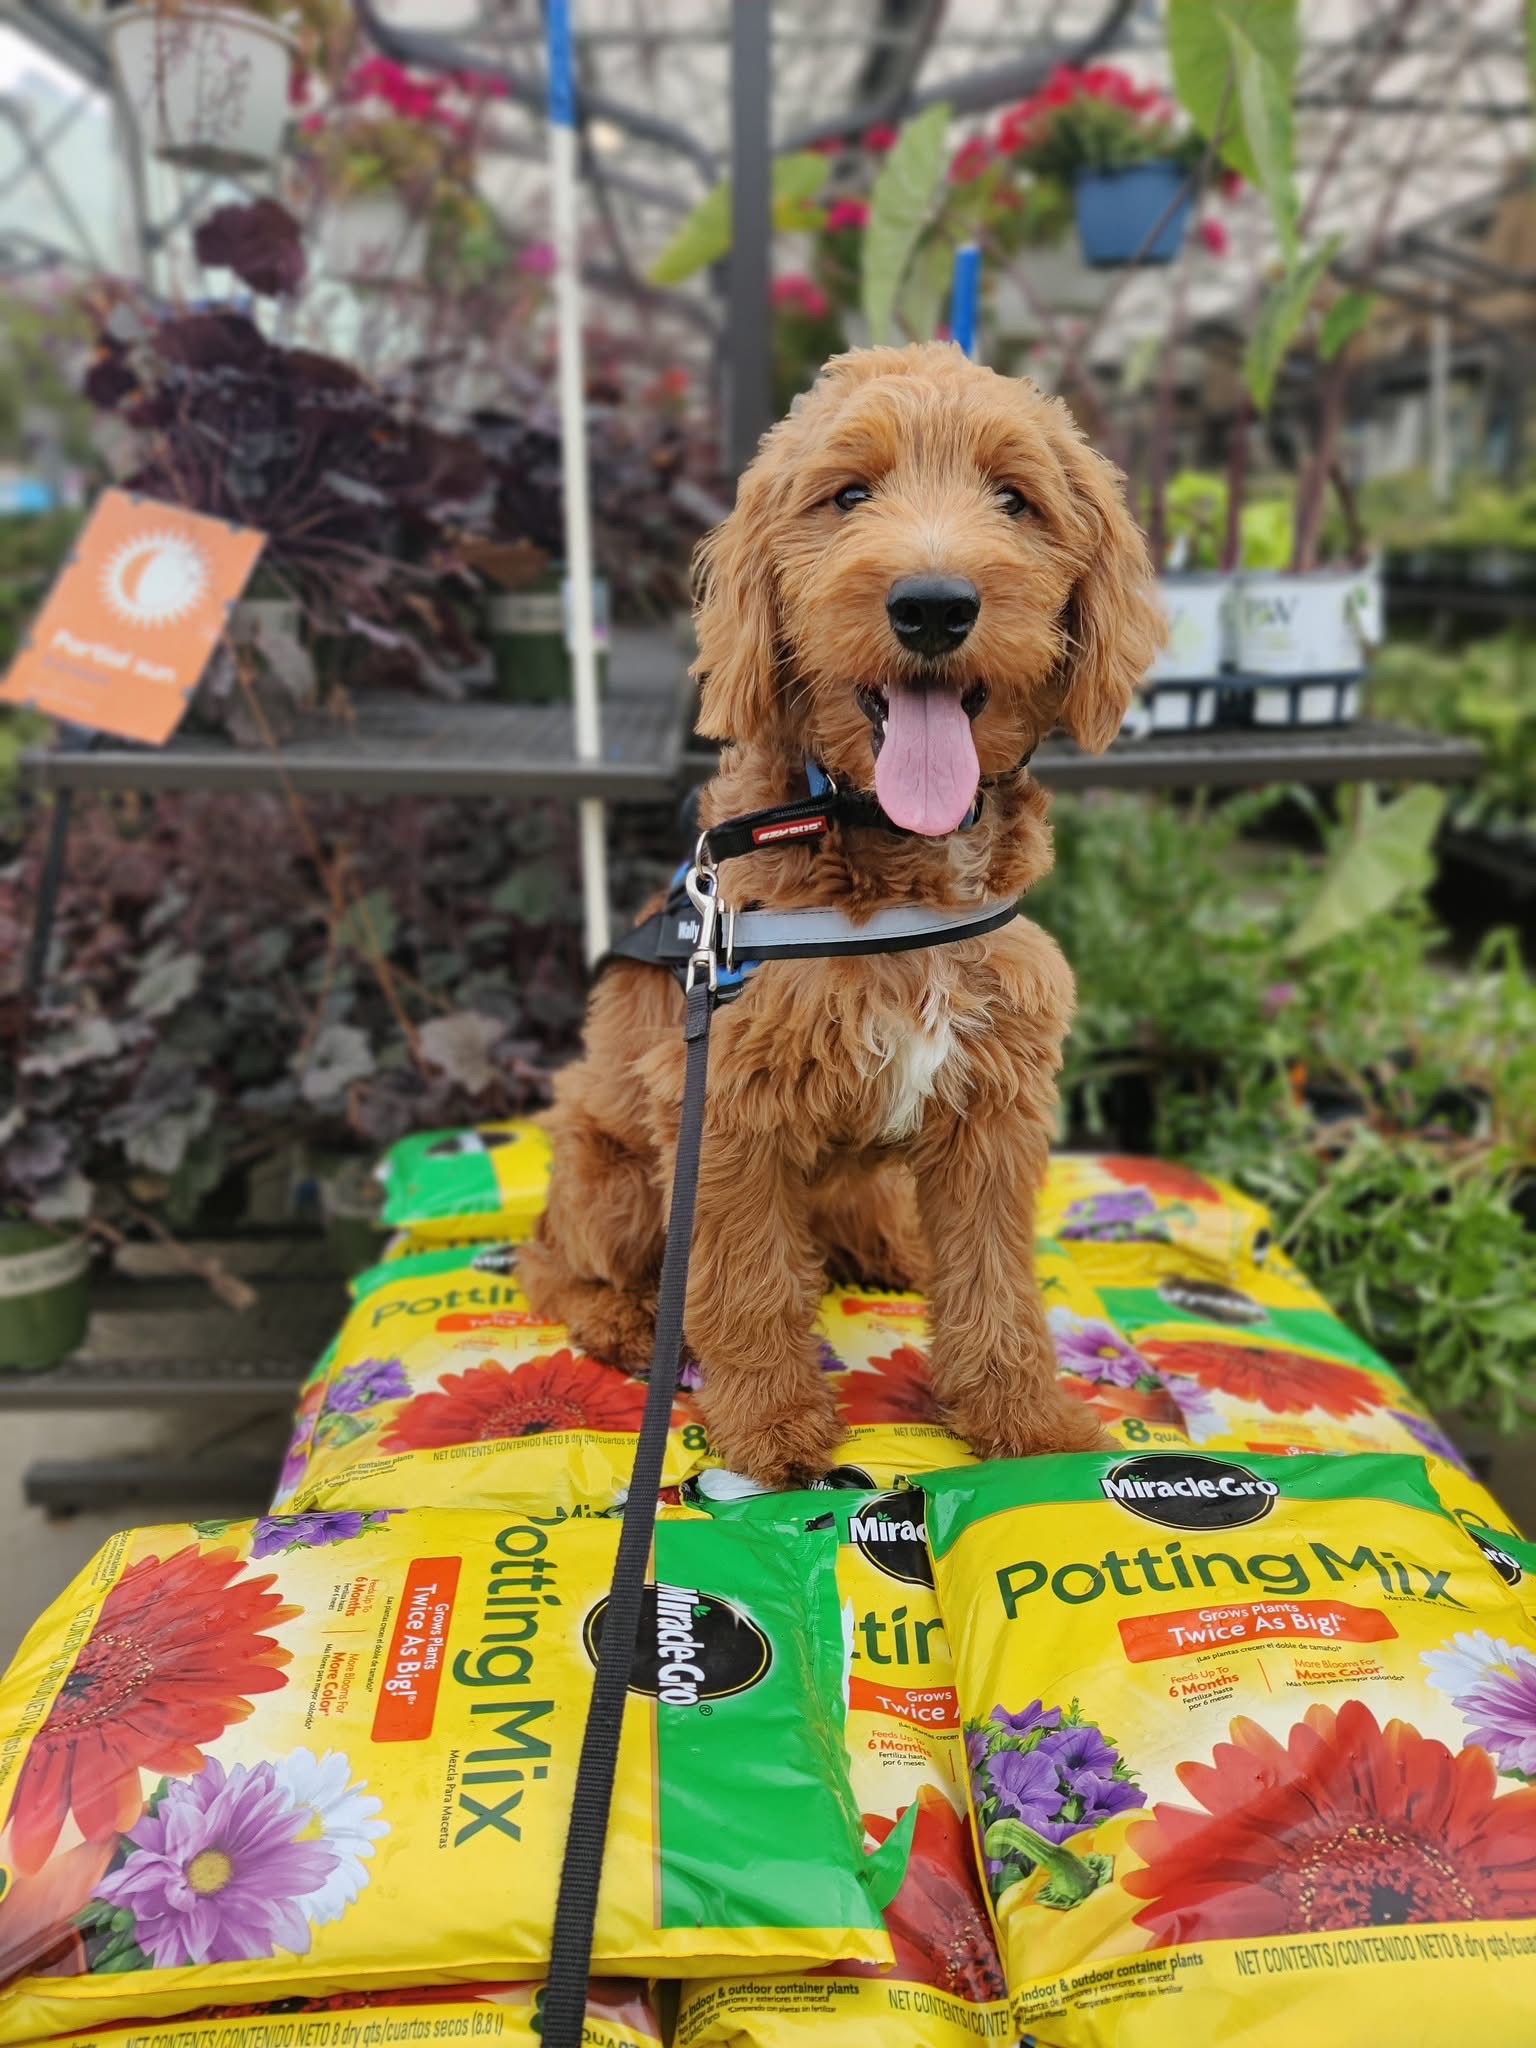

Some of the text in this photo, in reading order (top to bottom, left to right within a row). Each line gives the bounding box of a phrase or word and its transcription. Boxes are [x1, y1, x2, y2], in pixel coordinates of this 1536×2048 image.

[678, 920, 700, 943] Wally
[683, 1424, 707, 1451] 8
[893, 1427, 909, 1437] NET
[1122, 1418, 1150, 1442] 8
[433, 1450, 449, 1461] NET
[543, 1434, 563, 1447] NETO
[996, 1541, 1472, 1620] Potting Mix
[345, 1583, 367, 1617] Months
[363, 1603, 373, 1614] To
[365, 1592, 375, 1603] Up
[405, 1583, 437, 1630] Twice
[1199, 1603, 1300, 1623] Grows Plants
[423, 1602, 449, 1670] Grows Plants
[1167, 1624, 1246, 1648] Twice
[1255, 1615, 1286, 1633] As
[400, 1635, 426, 1657] As
[1212, 1649, 1239, 1660] plantas
[1240, 1644, 1265, 1653] crecen
[1275, 1642, 1297, 1650] doble
[327, 1652, 347, 1680] More
[1171, 1666, 1230, 1684] Feeds Up To
[1294, 1658, 1376, 1669] More Blooms For
[1295, 1669, 1337, 1680] More
[335, 1653, 359, 1714] More Blooms For
[1169, 1674, 1240, 1698] 6 Months
[1183, 1686, 1234, 1704] Fertiliza hasta
[876, 1695, 945, 1721] Twice
[905, 1691, 952, 1702] Grows
[1188, 1702, 1203, 1711] por
[1210, 1693, 1233, 1703] meses
[868, 1739, 932, 1758] 6 Months
[454, 1700, 555, 1848] Mix
[438, 1749, 460, 1849] Mezcla Para Macetas
[1235, 1949, 1261, 1976] NET
[1263, 1935, 1416, 1974] CONTENTS/CONTENIDO
[1415, 1933, 1453, 1960] NETO
[1454, 1933, 1463, 1956] 8
[1463, 1932, 1489, 1963] dry
[1071, 1968, 1115, 1989] outdoor
[1116, 1957, 1168, 1978] container
[1169, 1952, 1204, 1974] plants
[728, 1983, 771, 1996] outdoor
[774, 1982, 824, 1994] container
[826, 1982, 860, 1996] plants
[888, 1988, 911, 2011] NET
[297, 2019, 330, 2047] NETO
[331, 2023, 339, 2044] 8
[341, 2020, 362, 2046] dry
[362, 2018, 431, 2044] qts/cuartos
[432, 2015, 469, 2037] secos
